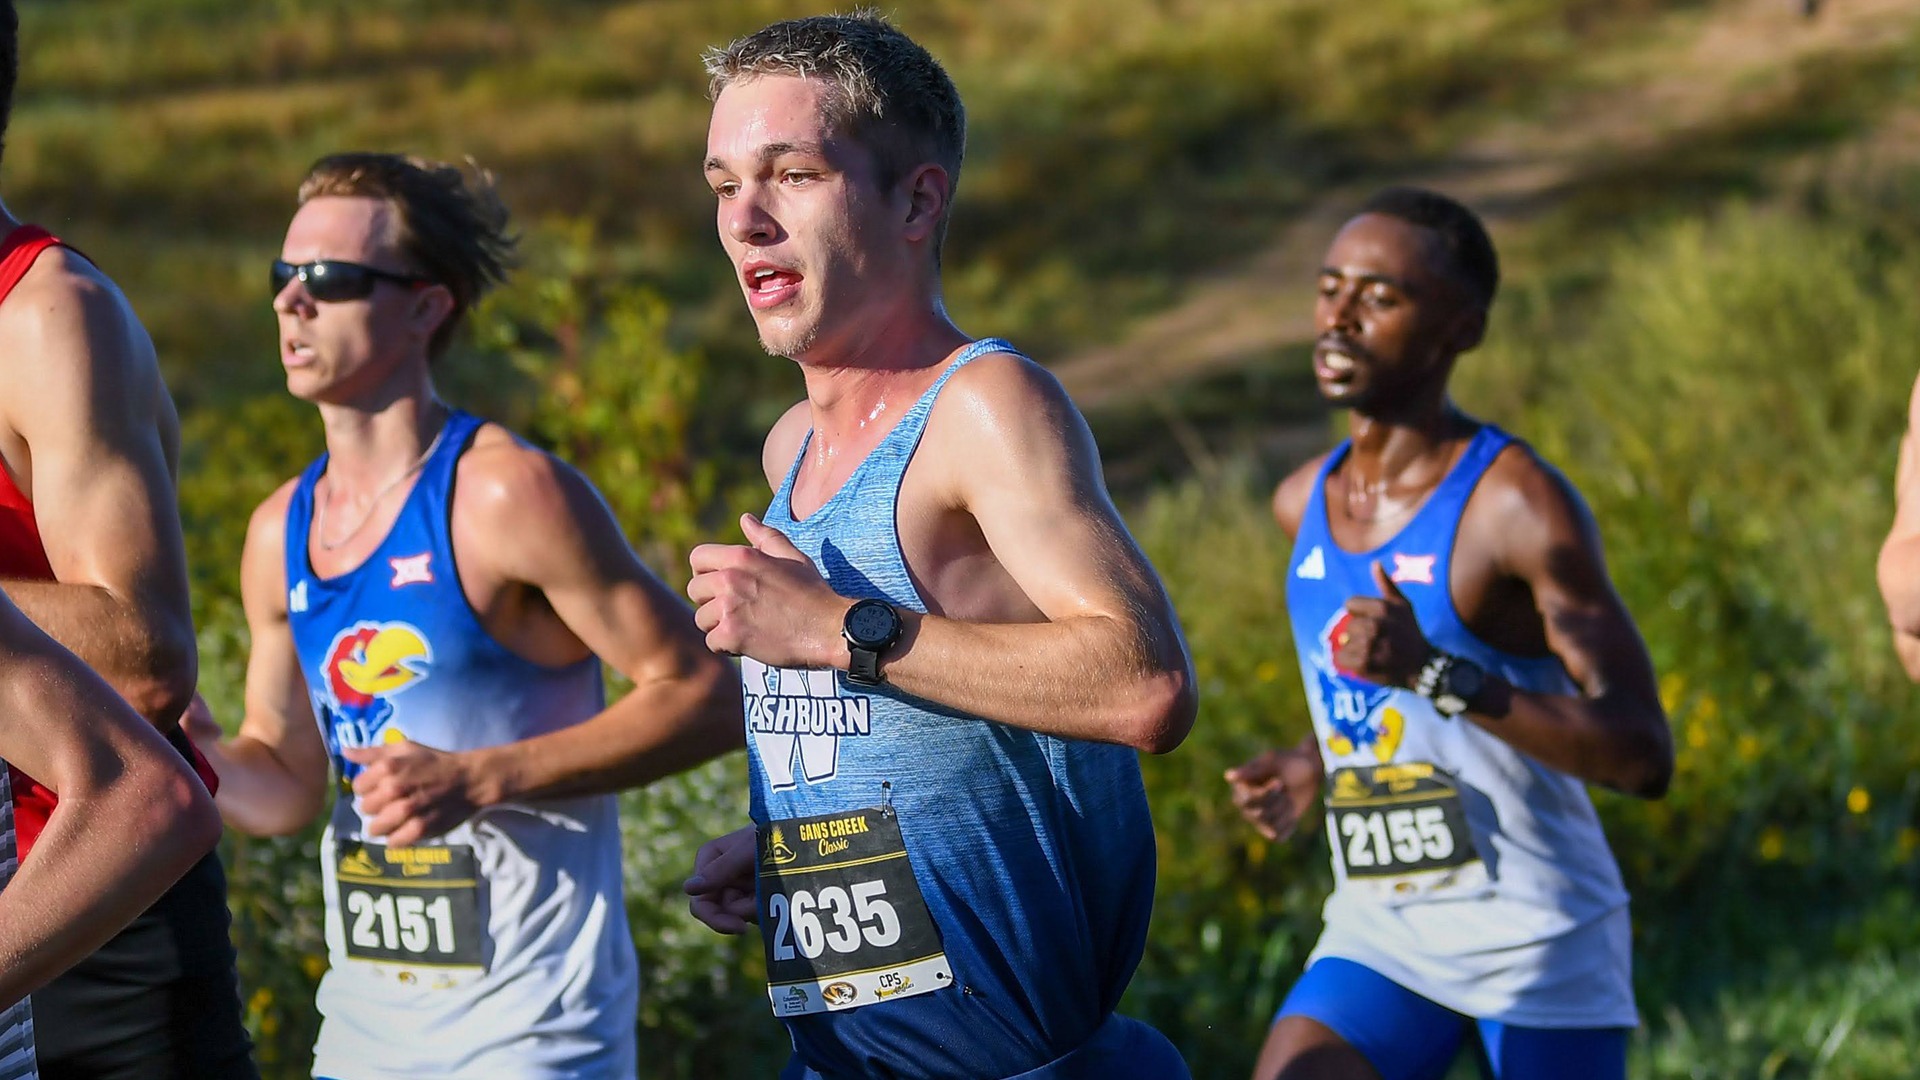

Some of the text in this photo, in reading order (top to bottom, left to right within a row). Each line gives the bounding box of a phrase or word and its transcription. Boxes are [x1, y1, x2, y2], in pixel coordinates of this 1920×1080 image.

[746, 695, 871, 737] ASHBURN
[799, 815, 870, 842] GANS CREEK
[818, 838, 850, 857] Classic
[1341, 805, 1455, 867] 2155
[347, 890, 456, 954] 2151
[769, 879, 902, 962] 2635
[878, 972, 902, 989] CPS
